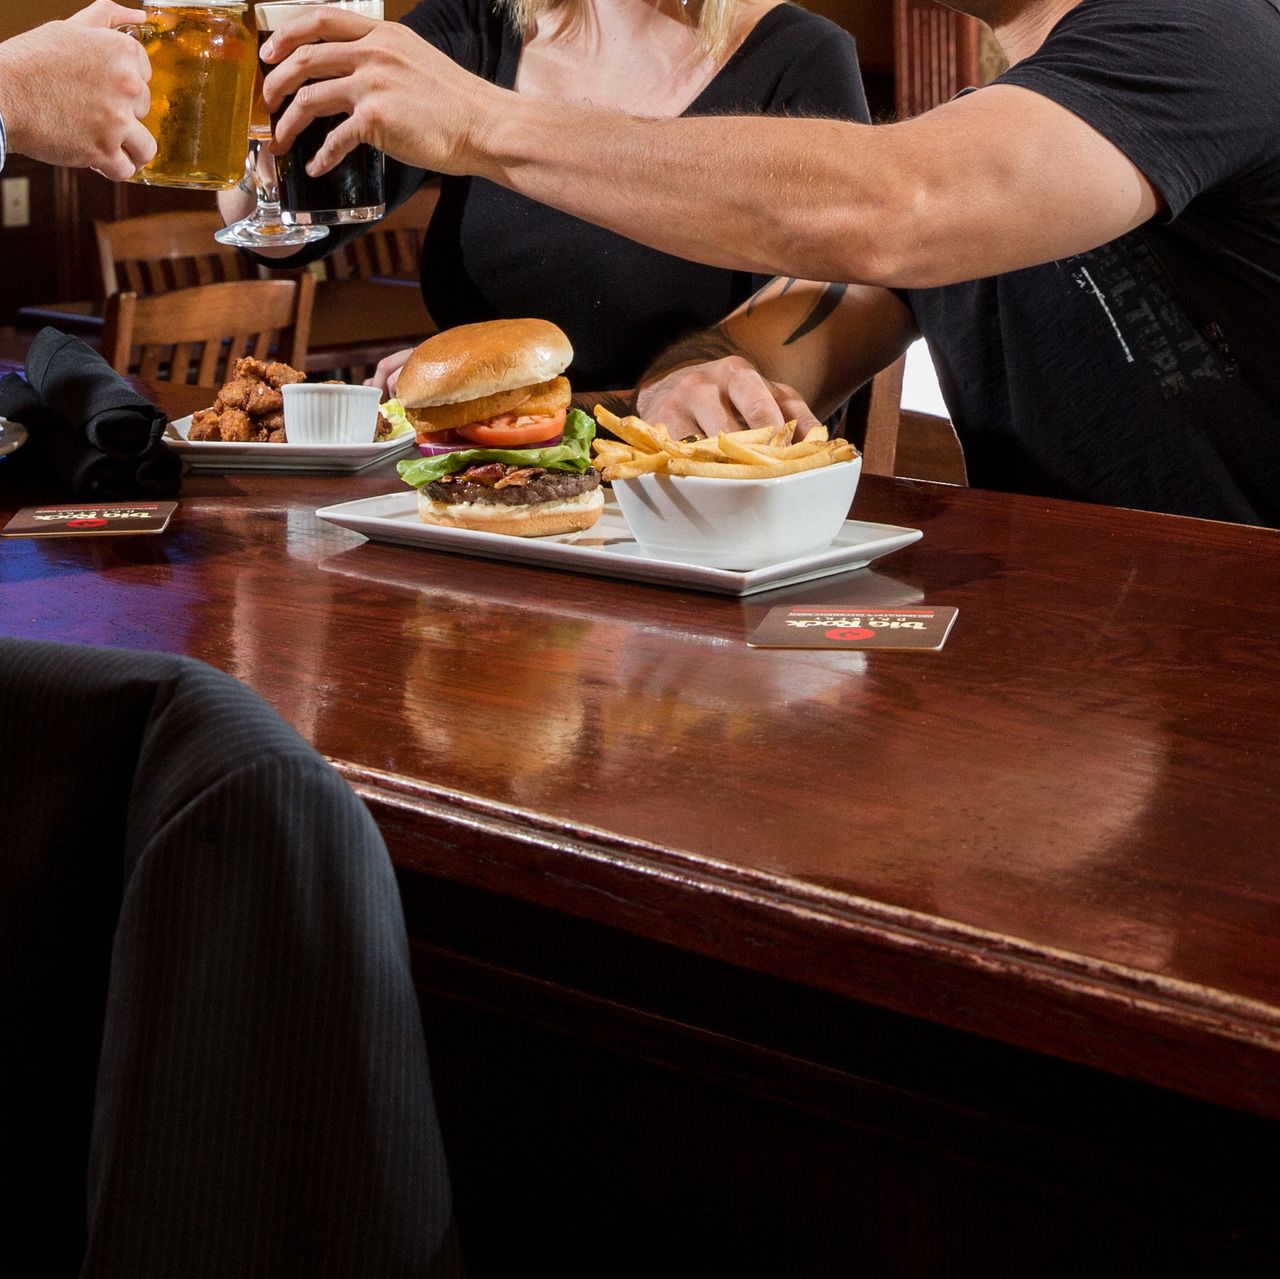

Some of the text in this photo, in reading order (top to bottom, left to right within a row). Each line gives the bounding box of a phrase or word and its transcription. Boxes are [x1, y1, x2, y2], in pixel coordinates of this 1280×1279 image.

[33, 512, 97, 521] Rock
[784, 620, 928, 630] big Rock
